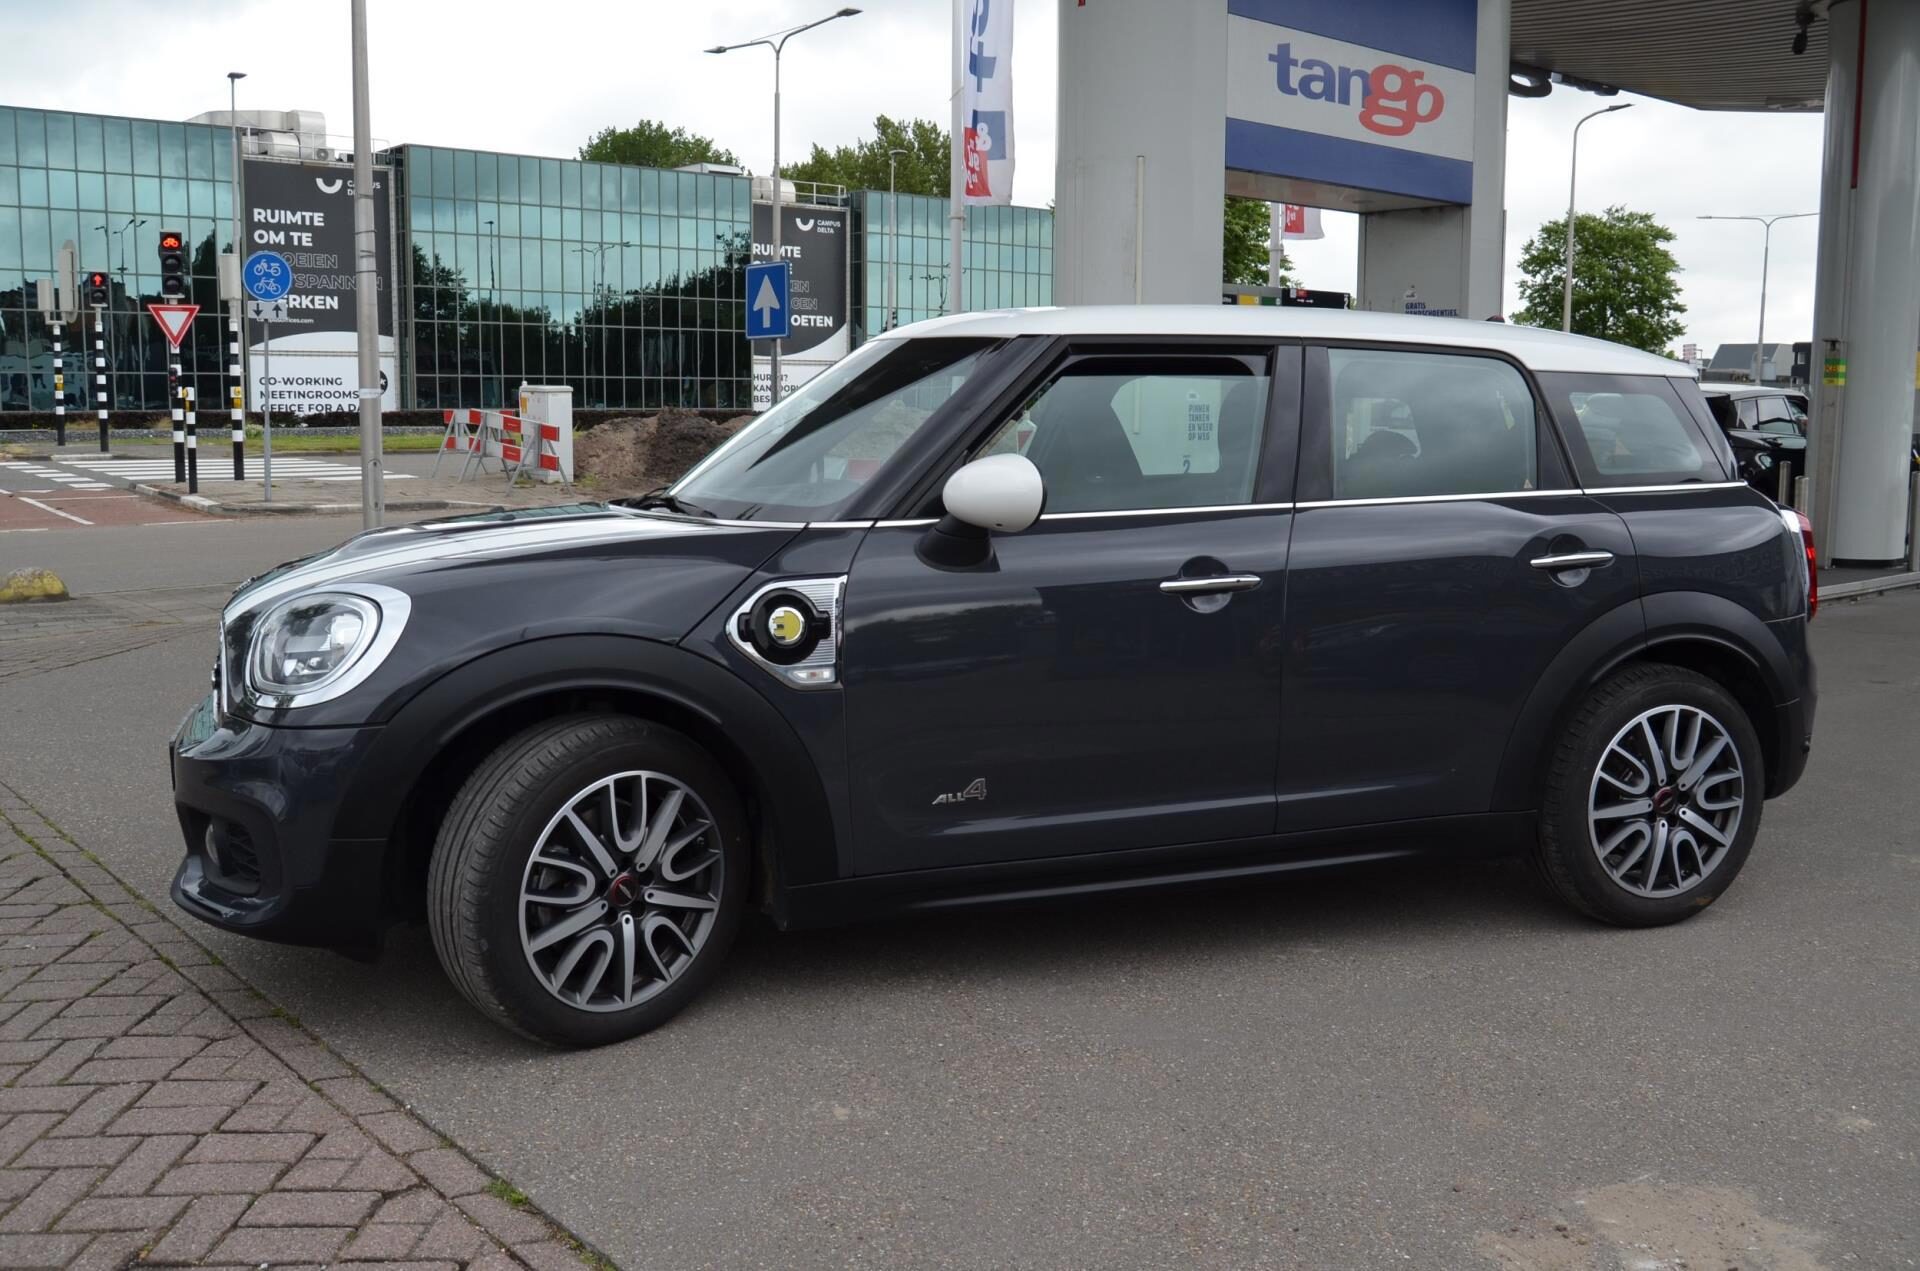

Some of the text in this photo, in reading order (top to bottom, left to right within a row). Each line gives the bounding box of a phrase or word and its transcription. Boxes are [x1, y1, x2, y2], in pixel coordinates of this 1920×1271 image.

[1268, 42, 1445, 136] tango
[253, 208, 325, 227] RUIMTE
[817, 220, 841, 228] CAMPUS
[253, 230, 313, 247] OM TE
[1405, 302, 1426, 310] GRATIS
[259, 377, 343, 386] CO-WORKING
[308, 403, 331, 412] FOR
[333, 403, 345, 412] A
